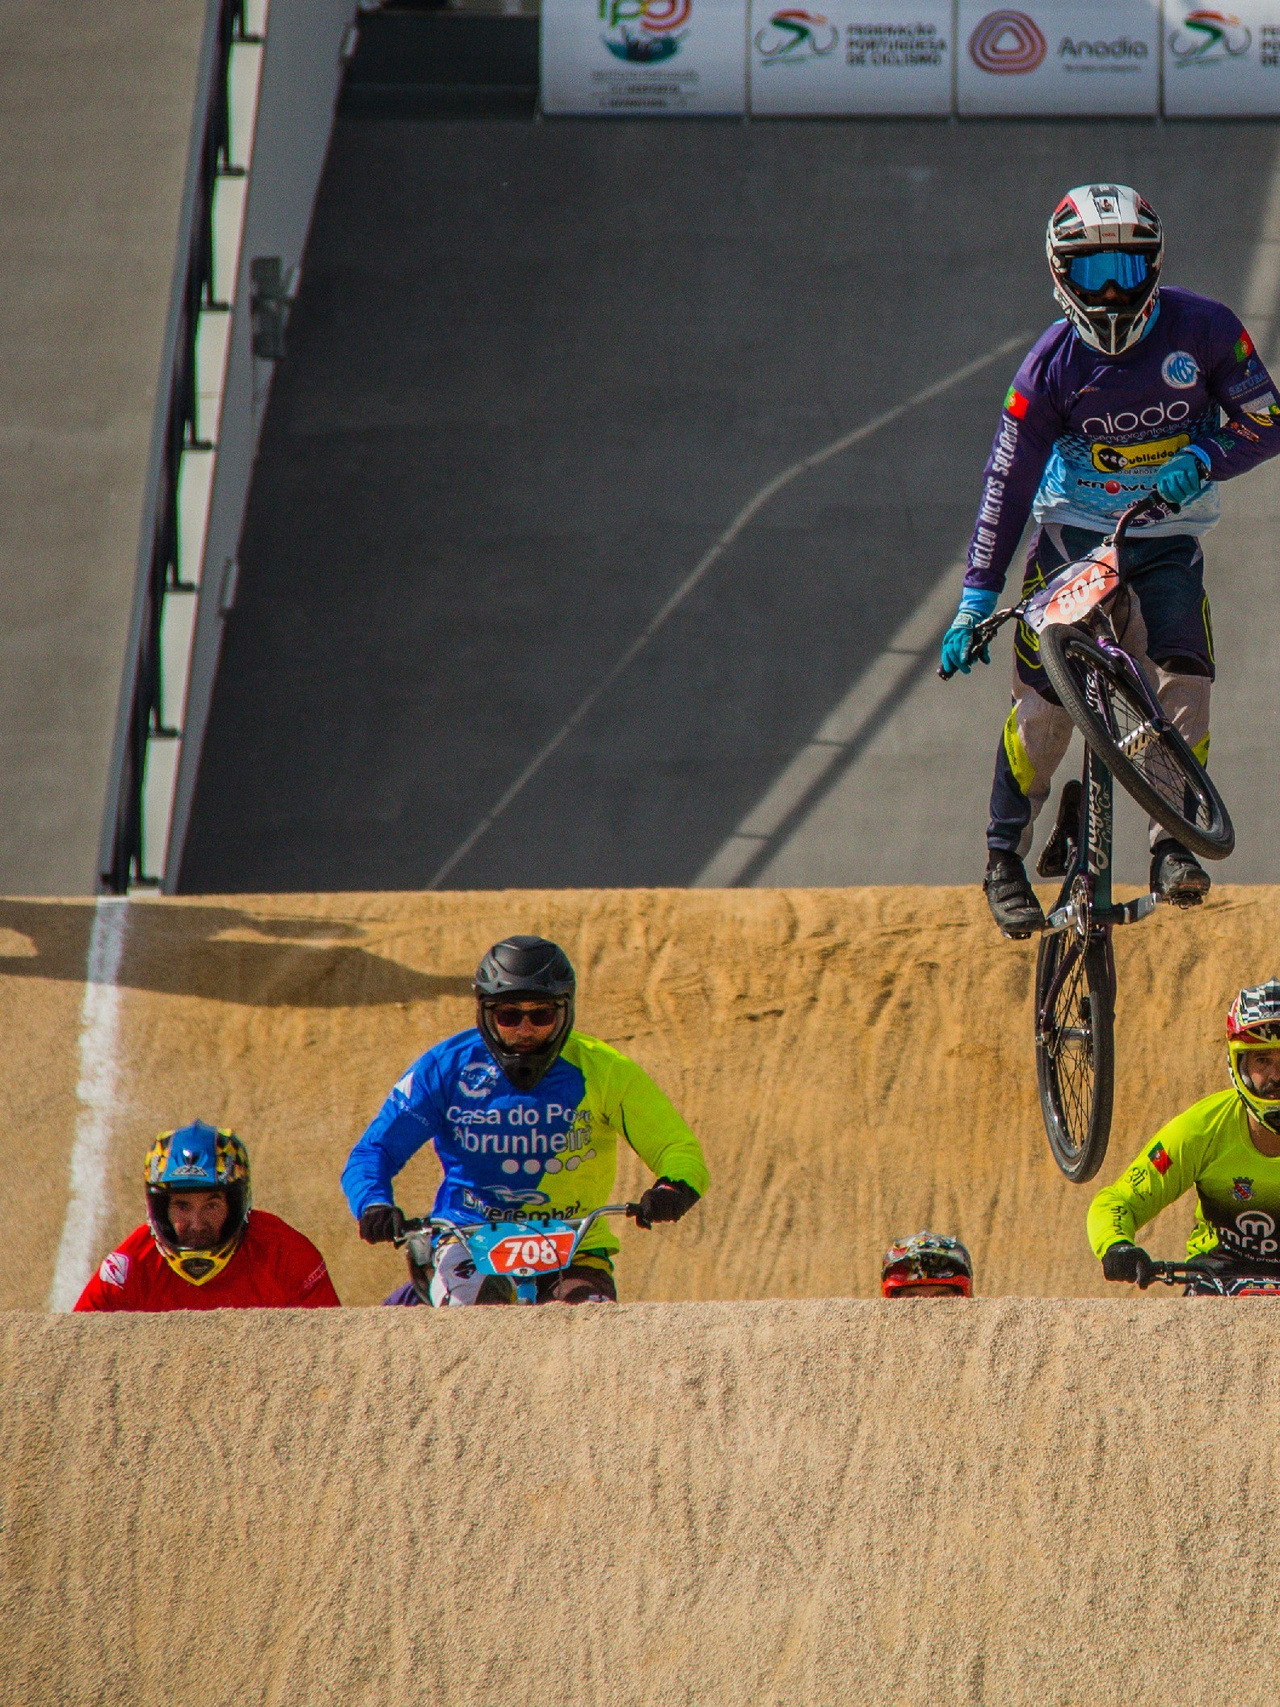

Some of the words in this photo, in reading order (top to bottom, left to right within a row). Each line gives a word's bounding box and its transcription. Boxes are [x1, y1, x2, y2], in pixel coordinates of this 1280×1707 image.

[1058, 36, 1148, 59] Anadia
[1057, 566, 1105, 615] 804
[446, 1105, 501, 1125] Casa
[508, 1104, 540, 1126] do
[504, 1239, 558, 1267] 708
